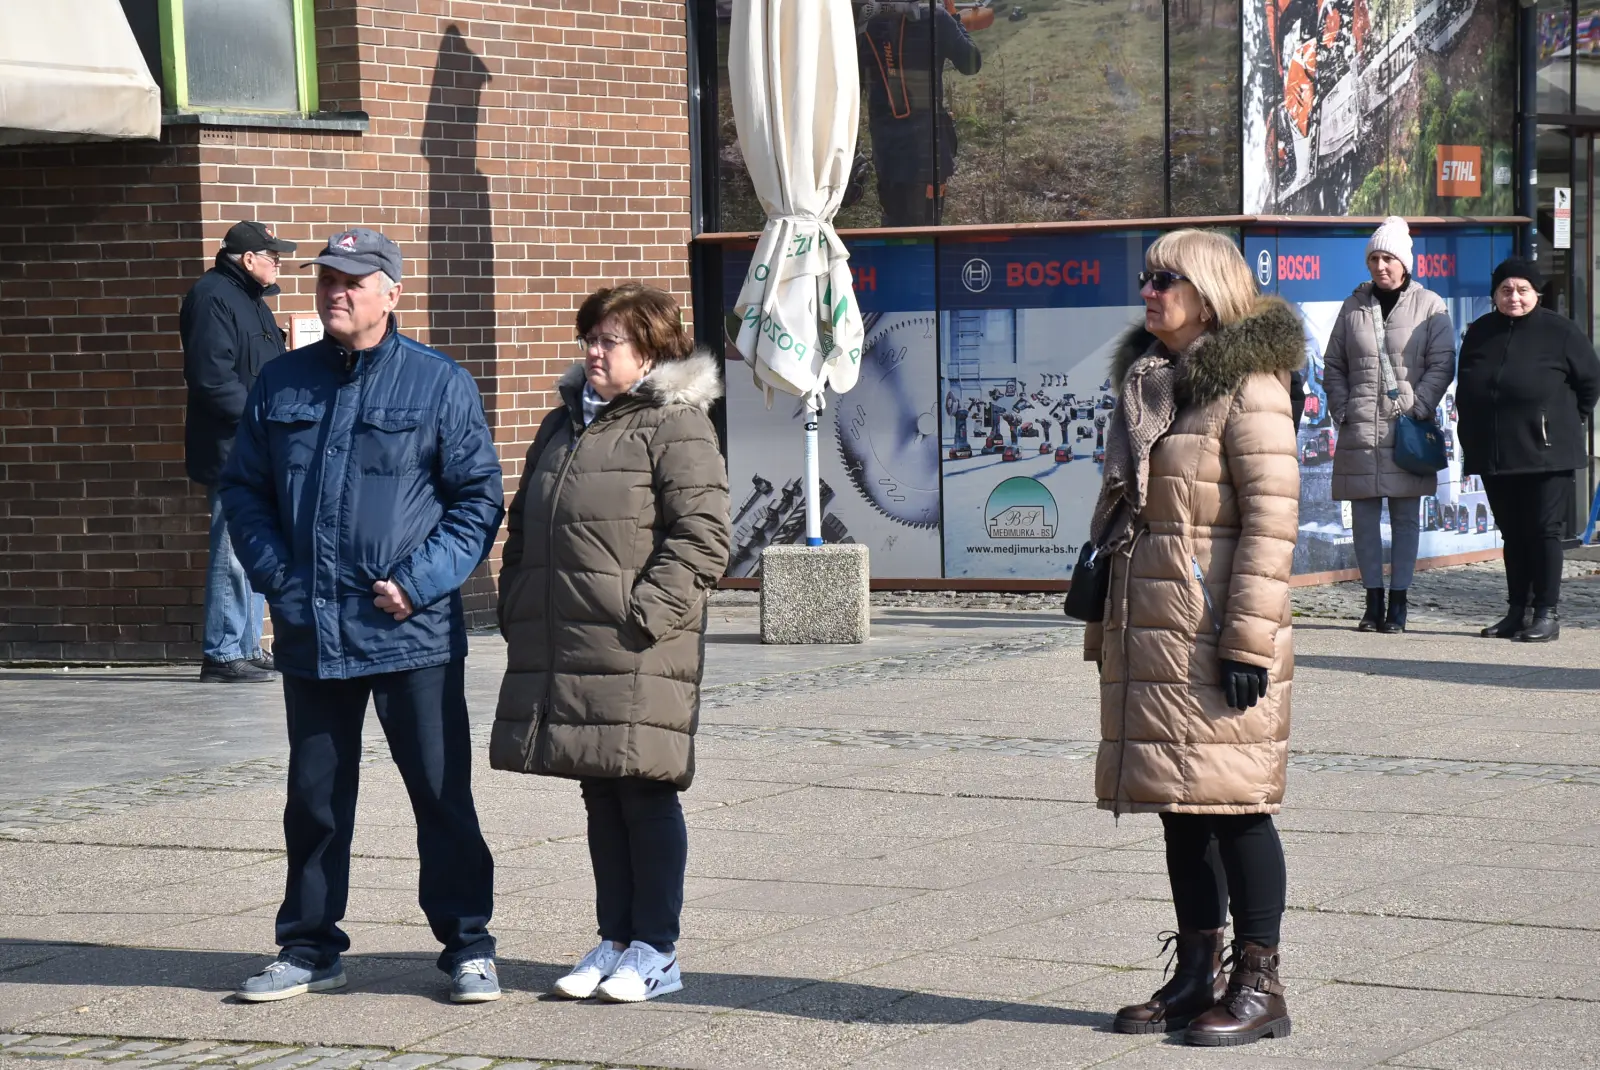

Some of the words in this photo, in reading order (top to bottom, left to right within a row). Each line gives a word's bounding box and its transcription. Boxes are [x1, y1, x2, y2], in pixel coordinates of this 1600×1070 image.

[1441, 160, 1476, 182] STIHL
[1007, 260, 1100, 287] BOSCH
[1278, 254, 1321, 281] BOSCH
[1417, 253, 1456, 279] BOSCH
[1040, 528, 1051, 537] BS
[966, 543, 1079, 556] www.medjimurka-bs.hr
